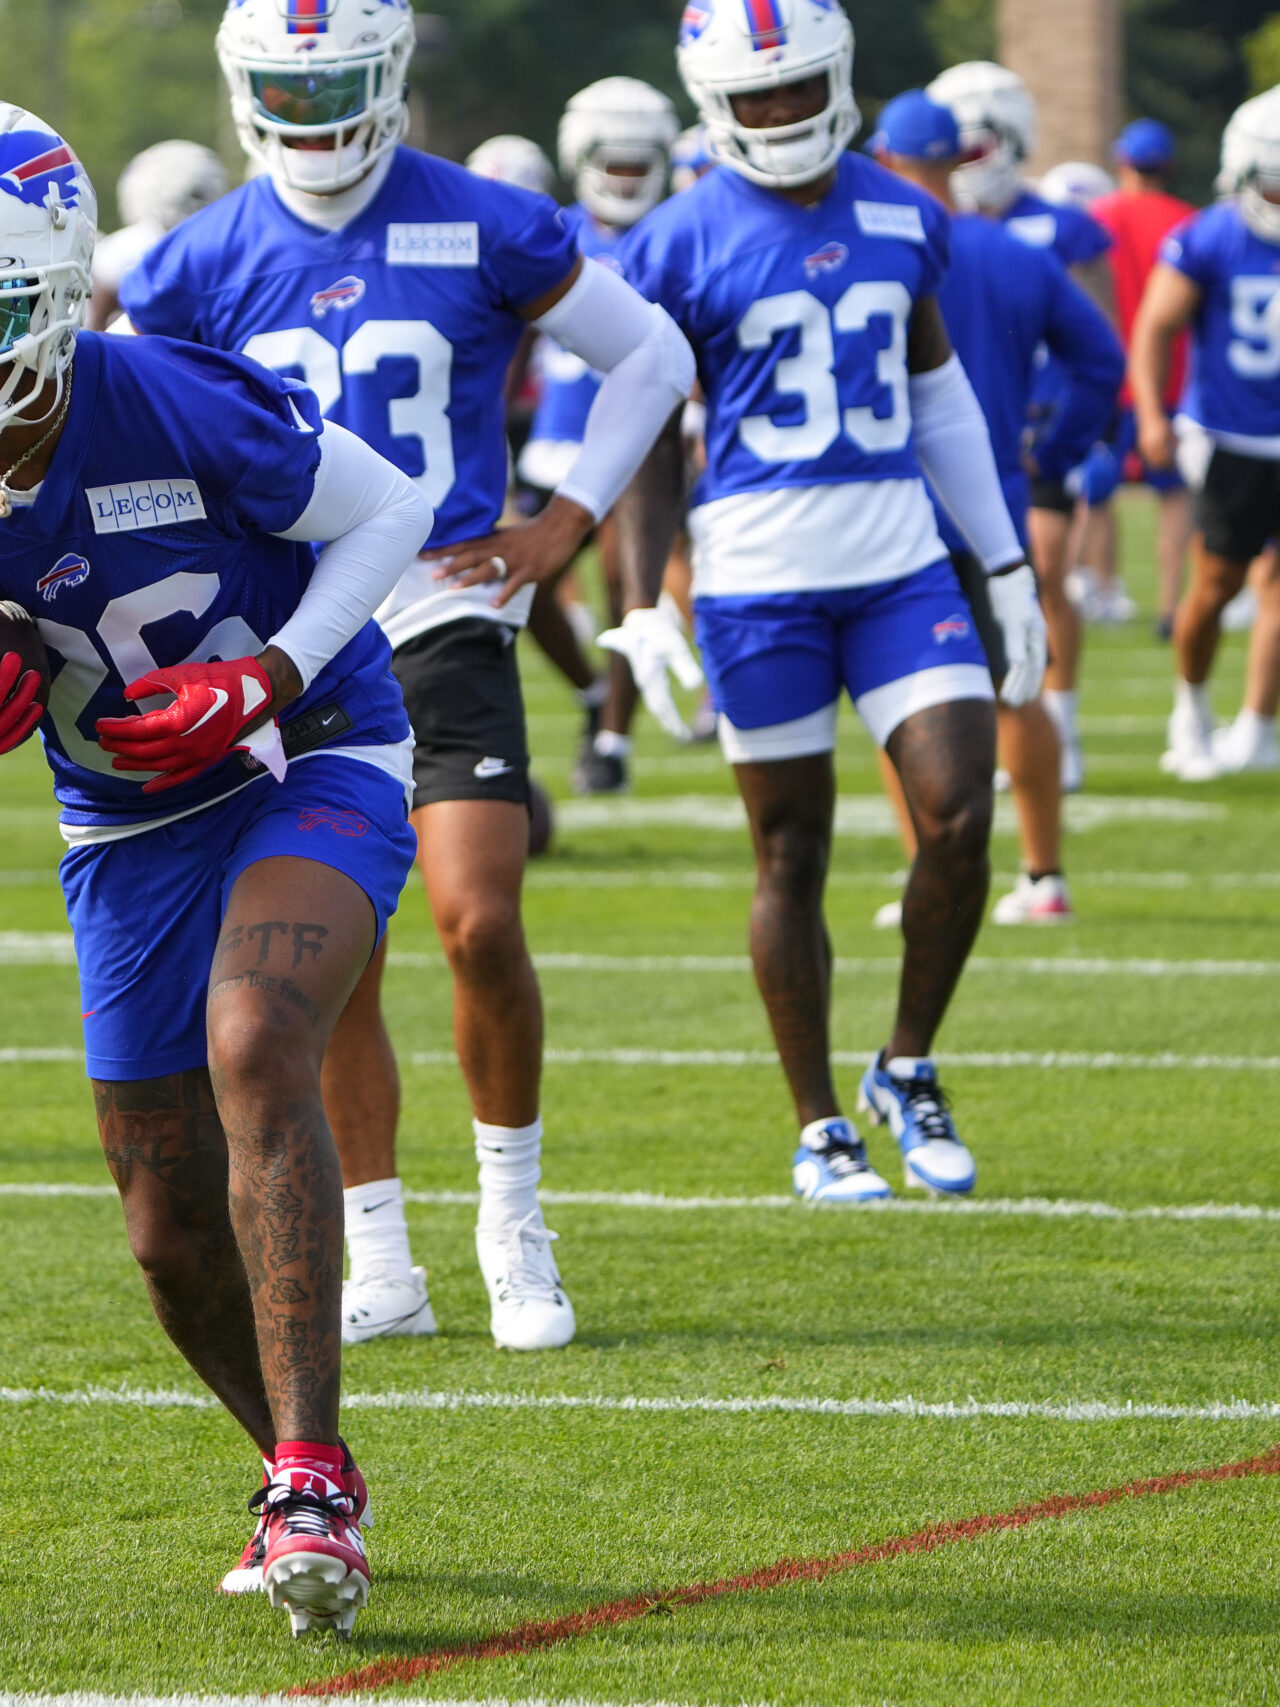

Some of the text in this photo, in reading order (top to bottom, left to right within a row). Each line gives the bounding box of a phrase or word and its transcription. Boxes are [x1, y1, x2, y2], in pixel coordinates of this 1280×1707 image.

[394, 236, 472, 249] LECOM
[738, 280, 913, 465] 33
[96, 491, 196, 517] LECOM
